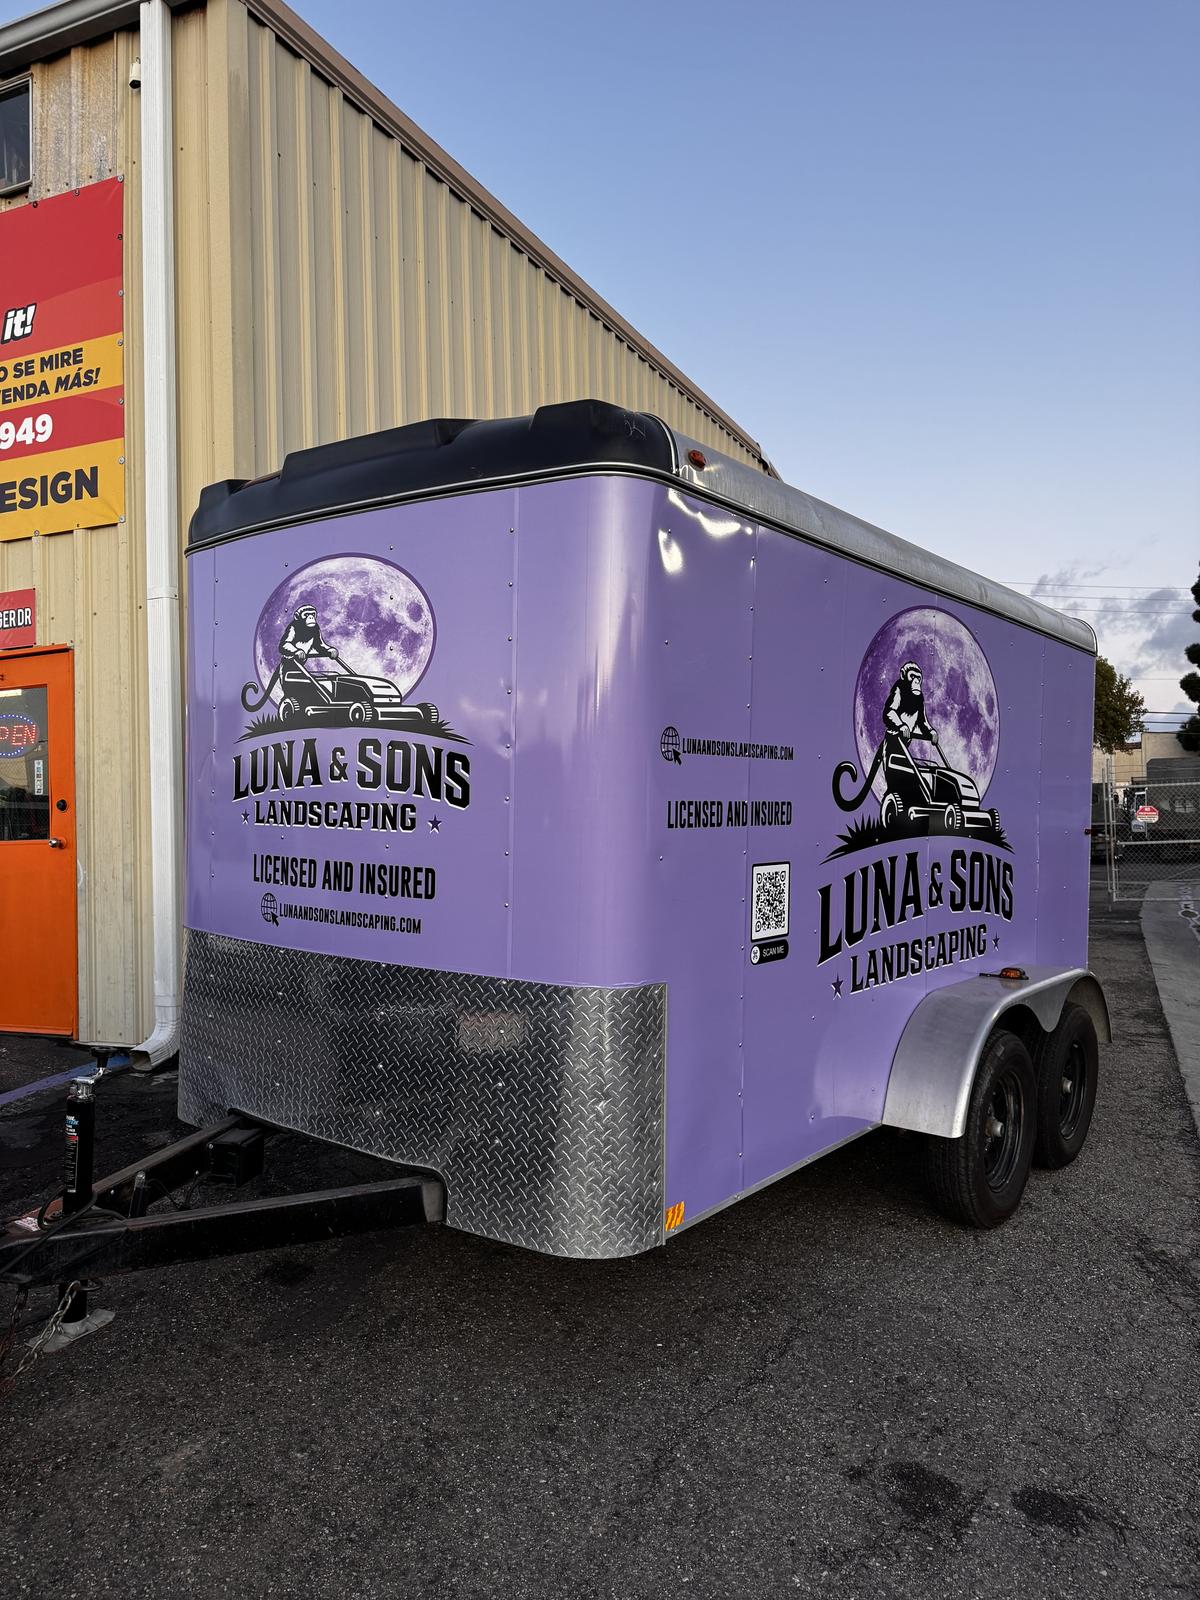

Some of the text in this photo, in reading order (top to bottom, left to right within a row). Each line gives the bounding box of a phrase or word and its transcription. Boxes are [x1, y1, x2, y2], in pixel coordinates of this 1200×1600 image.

[3, 304, 36, 342] it!
[13, 360, 35, 378] SE
[40, 348, 84, 373] MIRE
[0, 367, 101, 405] ENDA MÁS!
[0, 413, 53, 450] 949
[0, 466, 99, 513] ESIGN
[17, 607, 32, 627] DR
[683, 738, 794, 760] LUNAANDSONSLANDSCAPING.COM
[232, 738, 471, 811] LUNA & SONS
[254, 800, 417, 832] LANDSCAPING
[667, 800, 792, 829] LICENSED AND INSURED
[253, 853, 436, 900] LICENSED AND INSURED
[279, 902, 422, 934] LUNAANDSONSLANDSCAPING.COM
[817, 849, 1014, 967] LUNA & SONS
[762, 947, 777, 958] SCAN
[850, 923, 988, 995] LANDSCAPING
